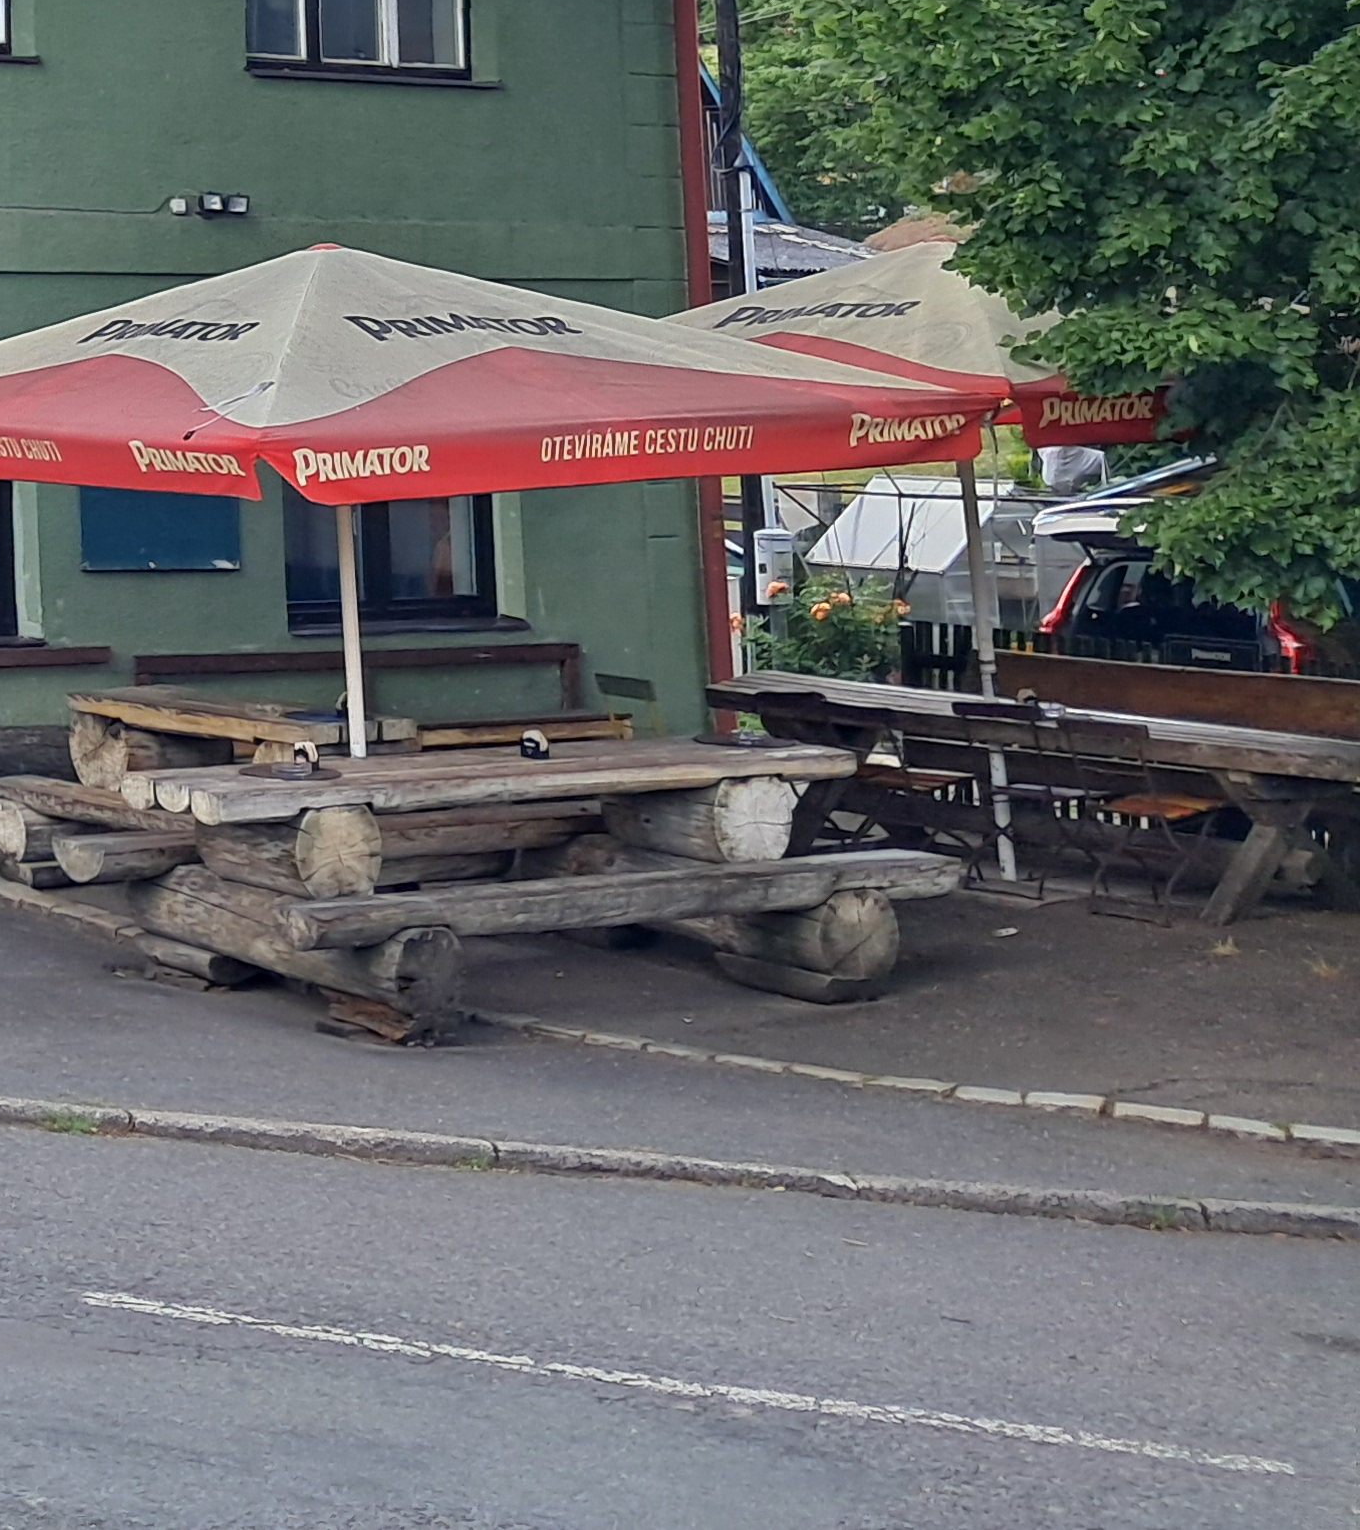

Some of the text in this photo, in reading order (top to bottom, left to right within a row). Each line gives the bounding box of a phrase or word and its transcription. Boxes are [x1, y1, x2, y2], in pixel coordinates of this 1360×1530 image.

[343, 312, 585, 342] PRIMATOR
[713, 300, 921, 330] PRIMATOR
[77, 318, 261, 344] PRIMATOR
[24, 439, 63, 462] CHUTI
[128, 439, 246, 478] PRIMATOR
[540, 425, 755, 463] OTEVÍRÁME CESTU CHUTI
[292, 444, 431, 487] PRIMATOR
